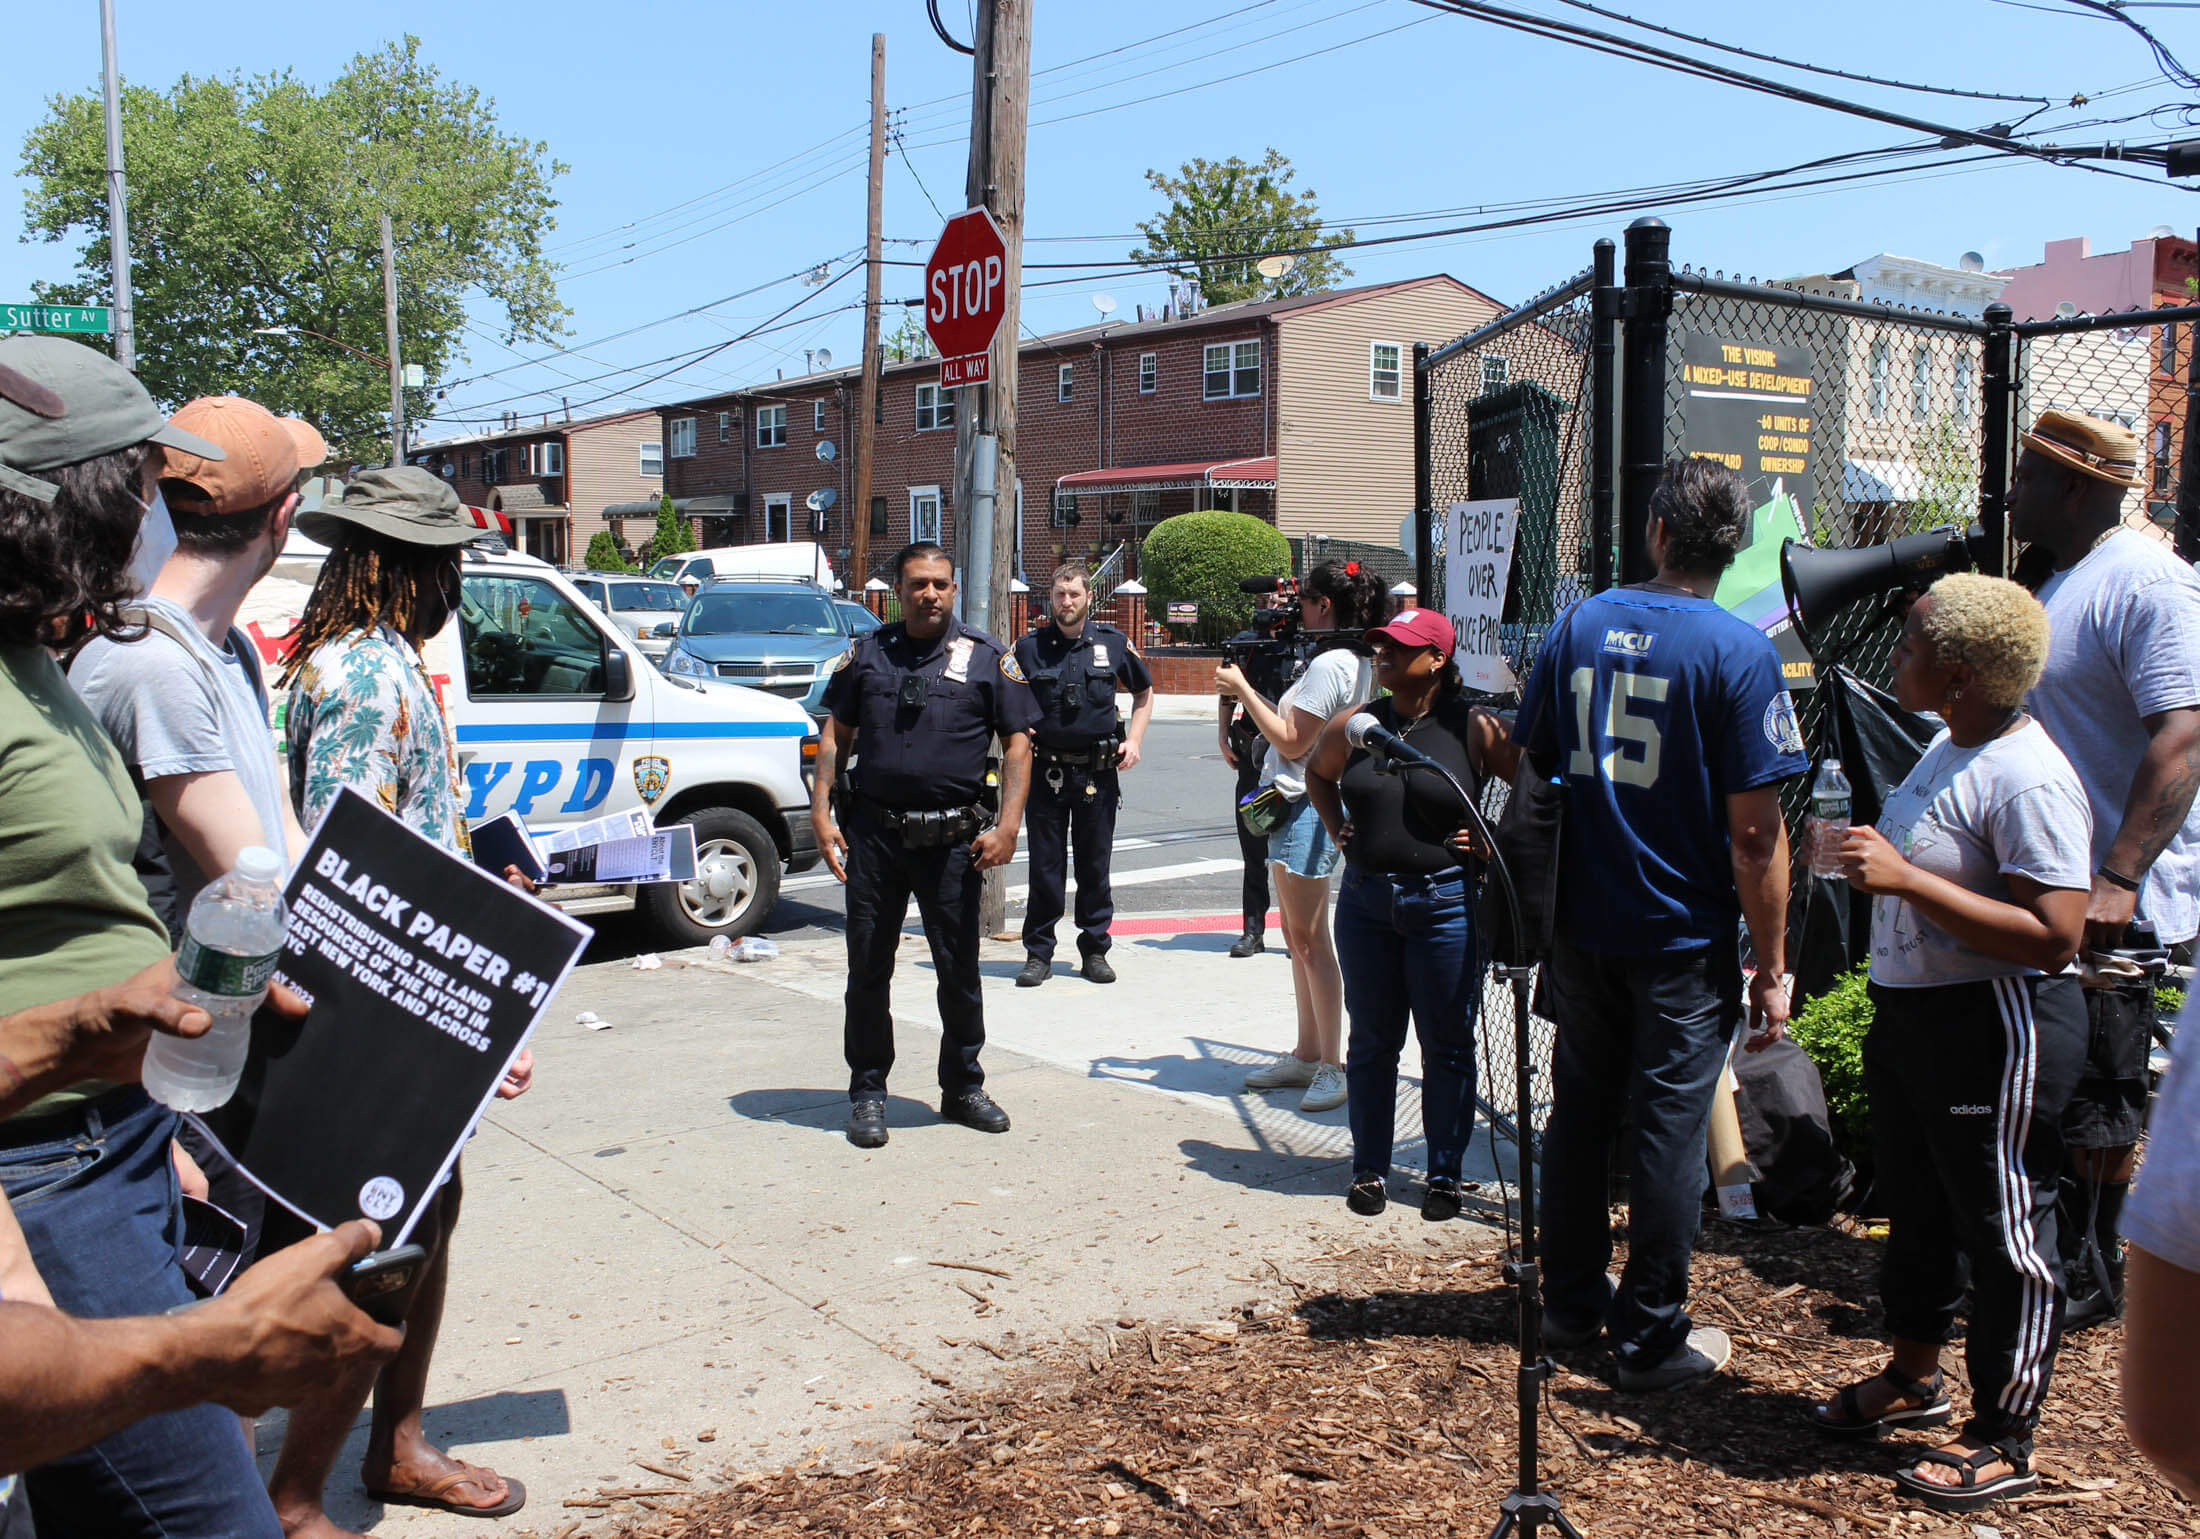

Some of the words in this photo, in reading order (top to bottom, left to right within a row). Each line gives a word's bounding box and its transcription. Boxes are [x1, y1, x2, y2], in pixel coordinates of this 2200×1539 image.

[931, 255, 1001, 323] STOP
[7, 307, 72, 328] Sutter
[81, 310, 95, 322] Av
[1722, 344, 1742, 363] THE
[944, 363, 961, 382] ALL
[966, 358, 986, 378] WAY
[1683, 364, 1691, 382] A
[1693, 366, 1747, 387] MIXED-USE
[1749, 372, 1811, 395] DEVELOPMENT
[1774, 415, 1797, 432] UNITS
[1799, 418, 1810, 433] OF
[1758, 435, 1809, 454] COOP/CONDO
[1760, 456, 1806, 473] OWNERSHIP
[1459, 511, 1504, 555] PEOPLE
[1468, 562, 1497, 599] OVER
[1604, 630, 1652, 650] MCU
[1781, 662, 1812, 678] ACILITY
[1569, 667, 1670, 790] 15
[464, 758, 615, 818] YPD
[315, 848, 411, 928] BLACK
[407, 911, 511, 987] PAPER
[511, 971, 549, 1009] #1
[301, 883, 414, 968] REDISTRIBUTING
[415, 959, 448, 989] THE
[449, 980, 493, 1012] LAND
[271, 970, 290, 985] AY
[292, 898, 371, 961] RESOURCES
[368, 953, 392, 976] OF
[392, 965, 422, 996] THE
[422, 984, 467, 1019] NYPD
[467, 1010, 491, 1032] IN
[288, 915, 322, 946] EAST
[317, 940, 354, 970] NEW
[351, 961, 394, 999] YORK
[390, 988, 429, 1018] AND
[426, 1008, 492, 1053] ACROSS
[1950, 1104, 1992, 1115] adidas
